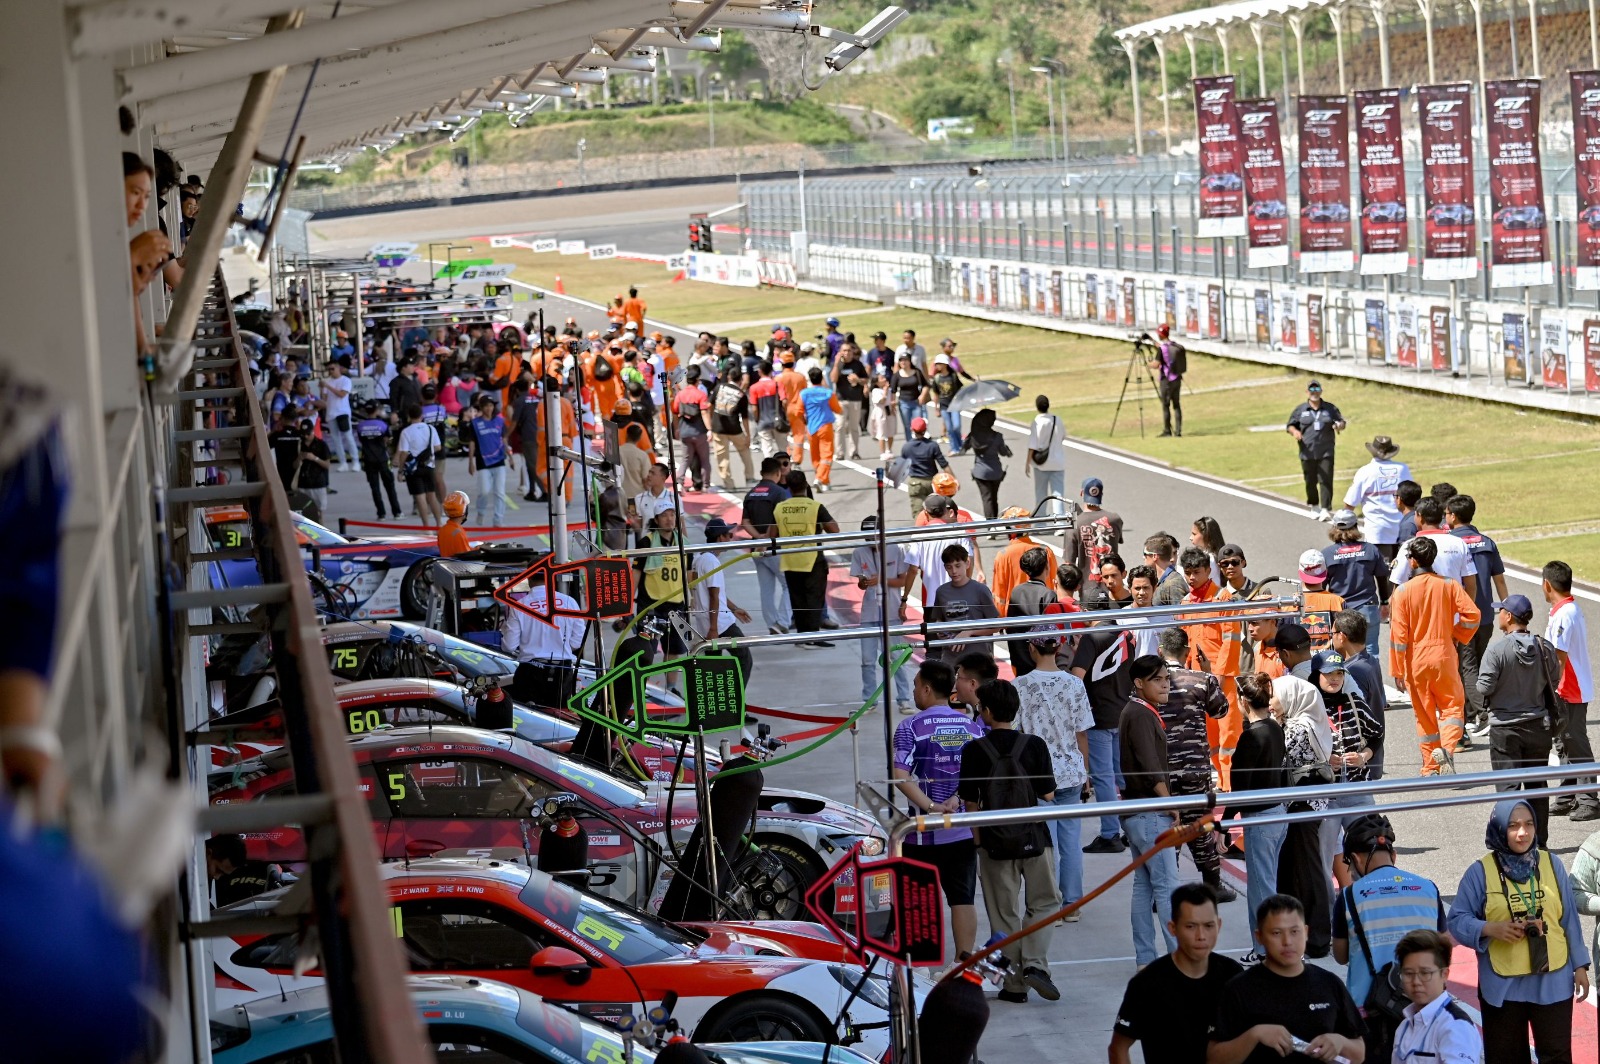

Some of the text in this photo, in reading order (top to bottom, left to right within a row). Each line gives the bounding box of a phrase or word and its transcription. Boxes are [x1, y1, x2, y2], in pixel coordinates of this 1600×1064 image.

[1426, 100, 1463, 112] GT
[1494, 96, 1531, 109] GT
[1430, 143, 1461, 151] WORLD
[1499, 142, 1532, 150] WORLD
[1431, 150, 1460, 158] CLASS
[536, 242, 554, 250] 100
[593, 247, 614, 257] 150
[670, 257, 684, 267] 20
[782, 506, 808, 514] SECURITY
[226, 531, 242, 547] 31
[661, 567, 678, 582] 80
[334, 649, 358, 668] 75
[1325, 654, 1342, 663] 46
[695, 668, 705, 720] RADIO CHECK
[705, 671, 716, 715] FUEL RESET
[716, 674, 726, 711] DRIVER ID
[726, 670, 737, 713] ENGINE OFF
[350, 710, 380, 733] 60
[389, 774, 406, 800] 5
[637, 821, 664, 829] Toto
[466, 849, 493, 858] 5
[768, 844, 807, 864] ZERO
[1510, 890, 1545, 903] SRO
[454, 1011, 465, 1019] LU
